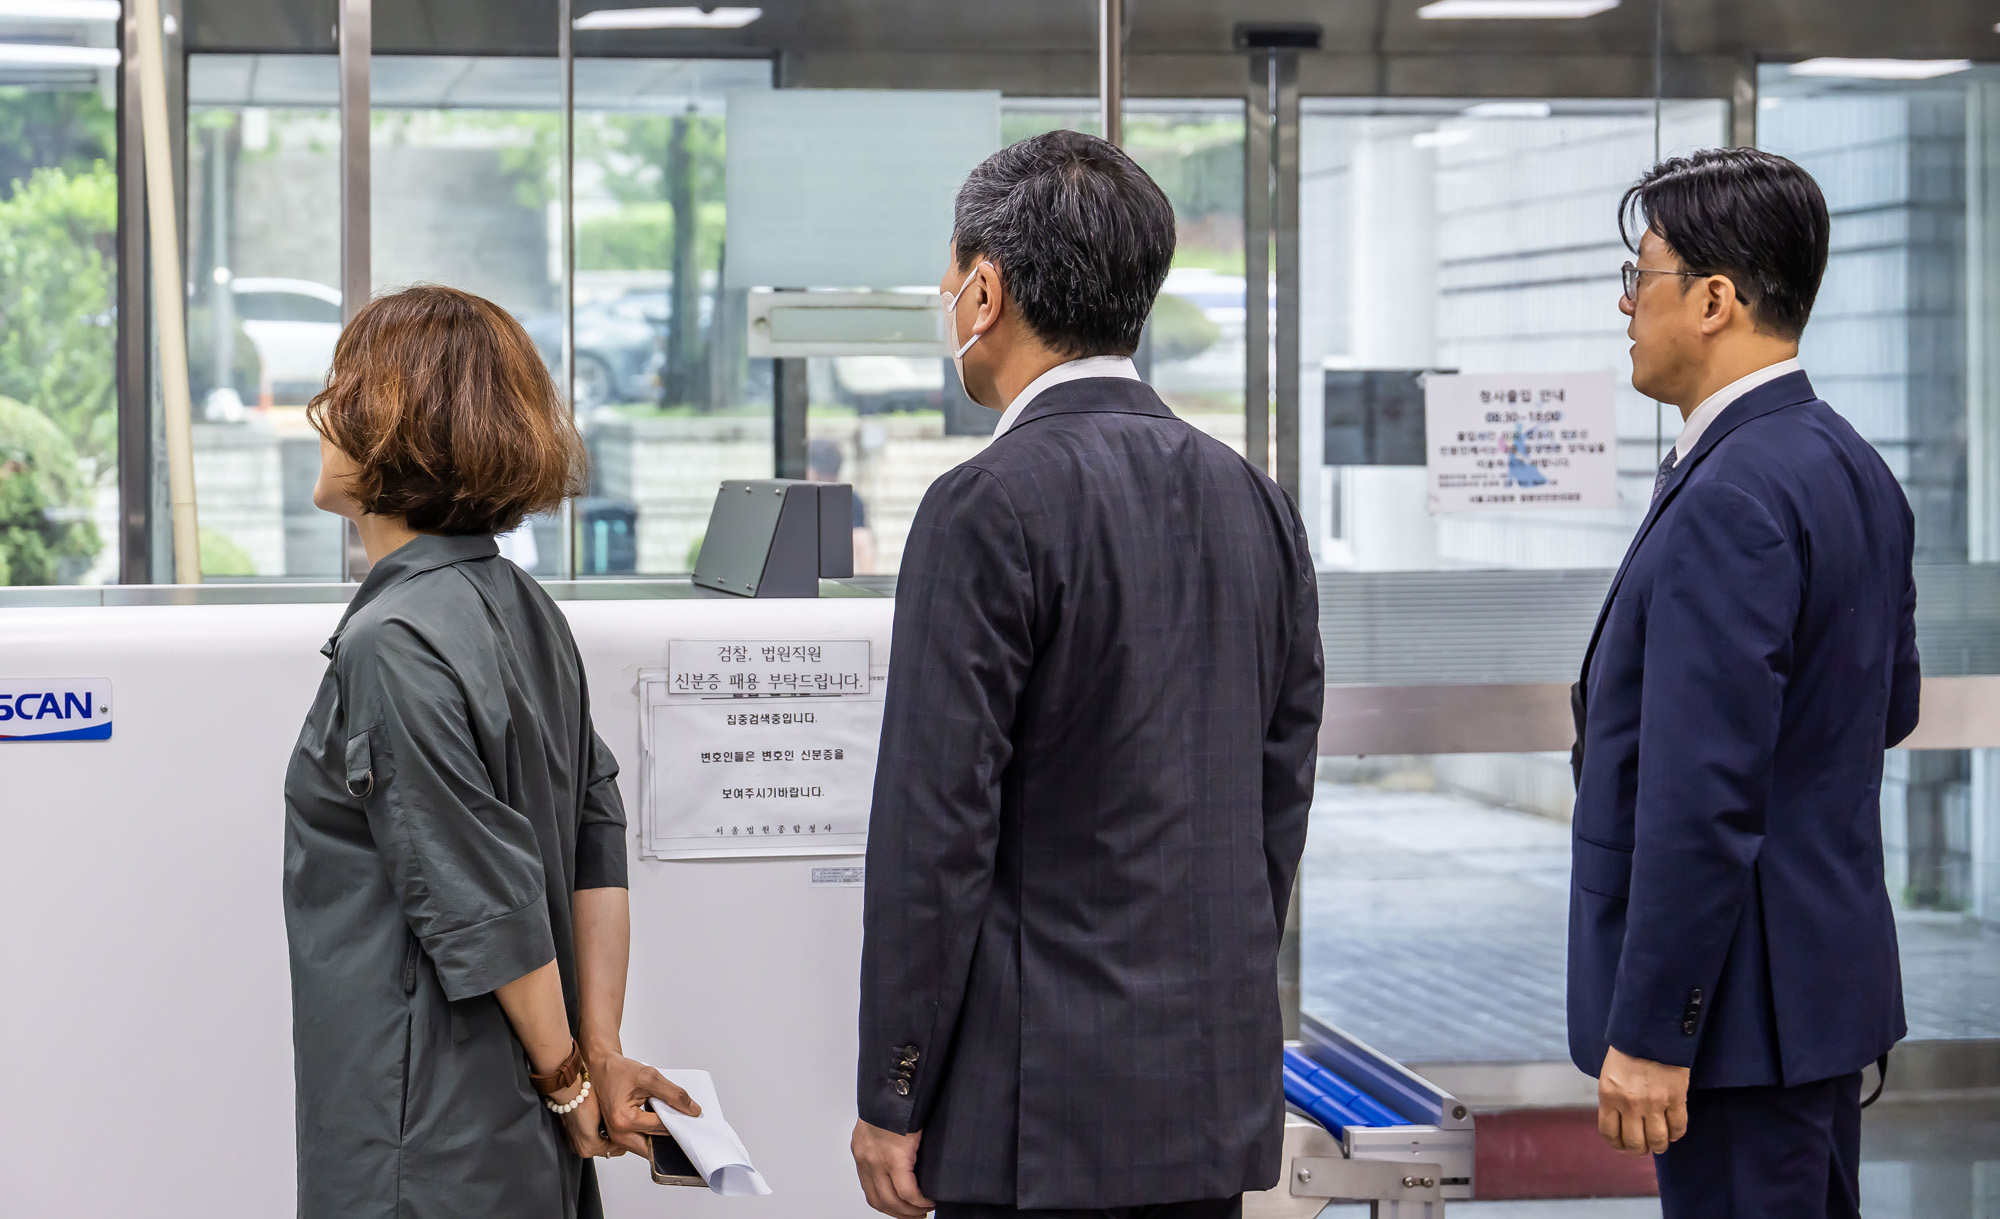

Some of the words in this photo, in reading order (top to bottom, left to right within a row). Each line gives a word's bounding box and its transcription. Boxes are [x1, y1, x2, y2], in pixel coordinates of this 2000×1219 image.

[1480, 390, 1531, 404] 청사출입
[1540, 389, 1566, 403] 안내
[718, 646, 751, 662] 검찰,
[762, 646, 821, 662] 법원직원
[675, 673, 721, 690] 신분증
[729, 673, 760, 690] 패용
[768, 673, 862, 690] 부탁드립니다.
[727, 713, 817, 725] 집중검색중입니다.
[701, 751, 755, 763] 변호인들은
[762, 750, 793, 761] 변호인
[801, 749, 844, 760] 신분증을
[723, 786, 824, 799] 보여주시기바랍니다.
